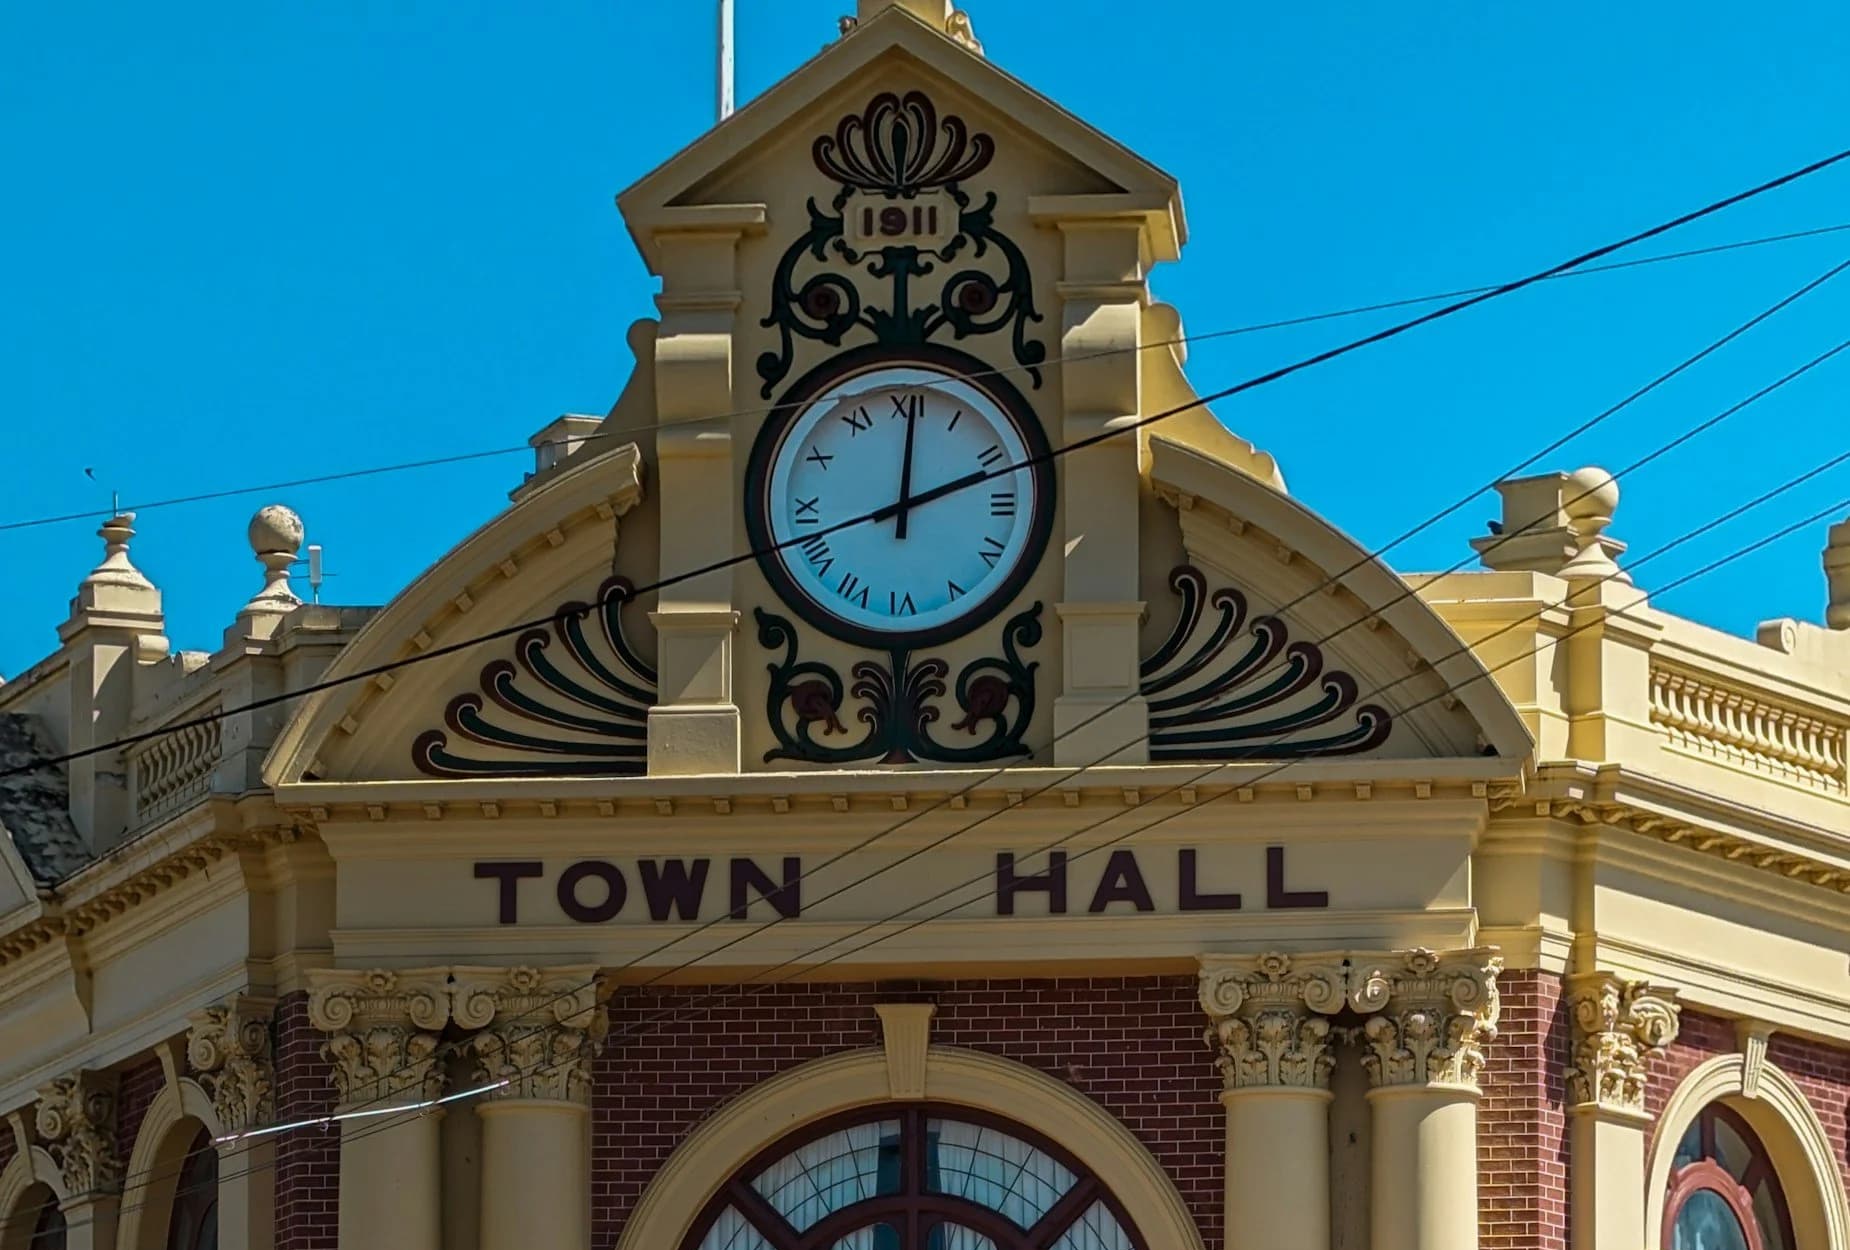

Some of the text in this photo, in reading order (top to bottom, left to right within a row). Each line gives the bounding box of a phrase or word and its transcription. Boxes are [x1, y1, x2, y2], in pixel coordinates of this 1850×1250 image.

[863, 205, 937, 237] 1911
[890, 394, 924, 419] XI
[842, 405, 873, 438] XI
[948, 410, 962, 432] I
[806, 445, 834, 471] X
[977, 445, 1003, 467] II
[795, 497, 819, 524] IX
[990, 493, 1015, 516] III
[801, 535, 834, 578] VIII
[978, 536, 1005, 569] IV
[837, 572, 869, 609] VII
[890, 591, 916, 616] VI
[948, 580, 968, 602] V
[474, 847, 1329, 924] TOWN HALL
